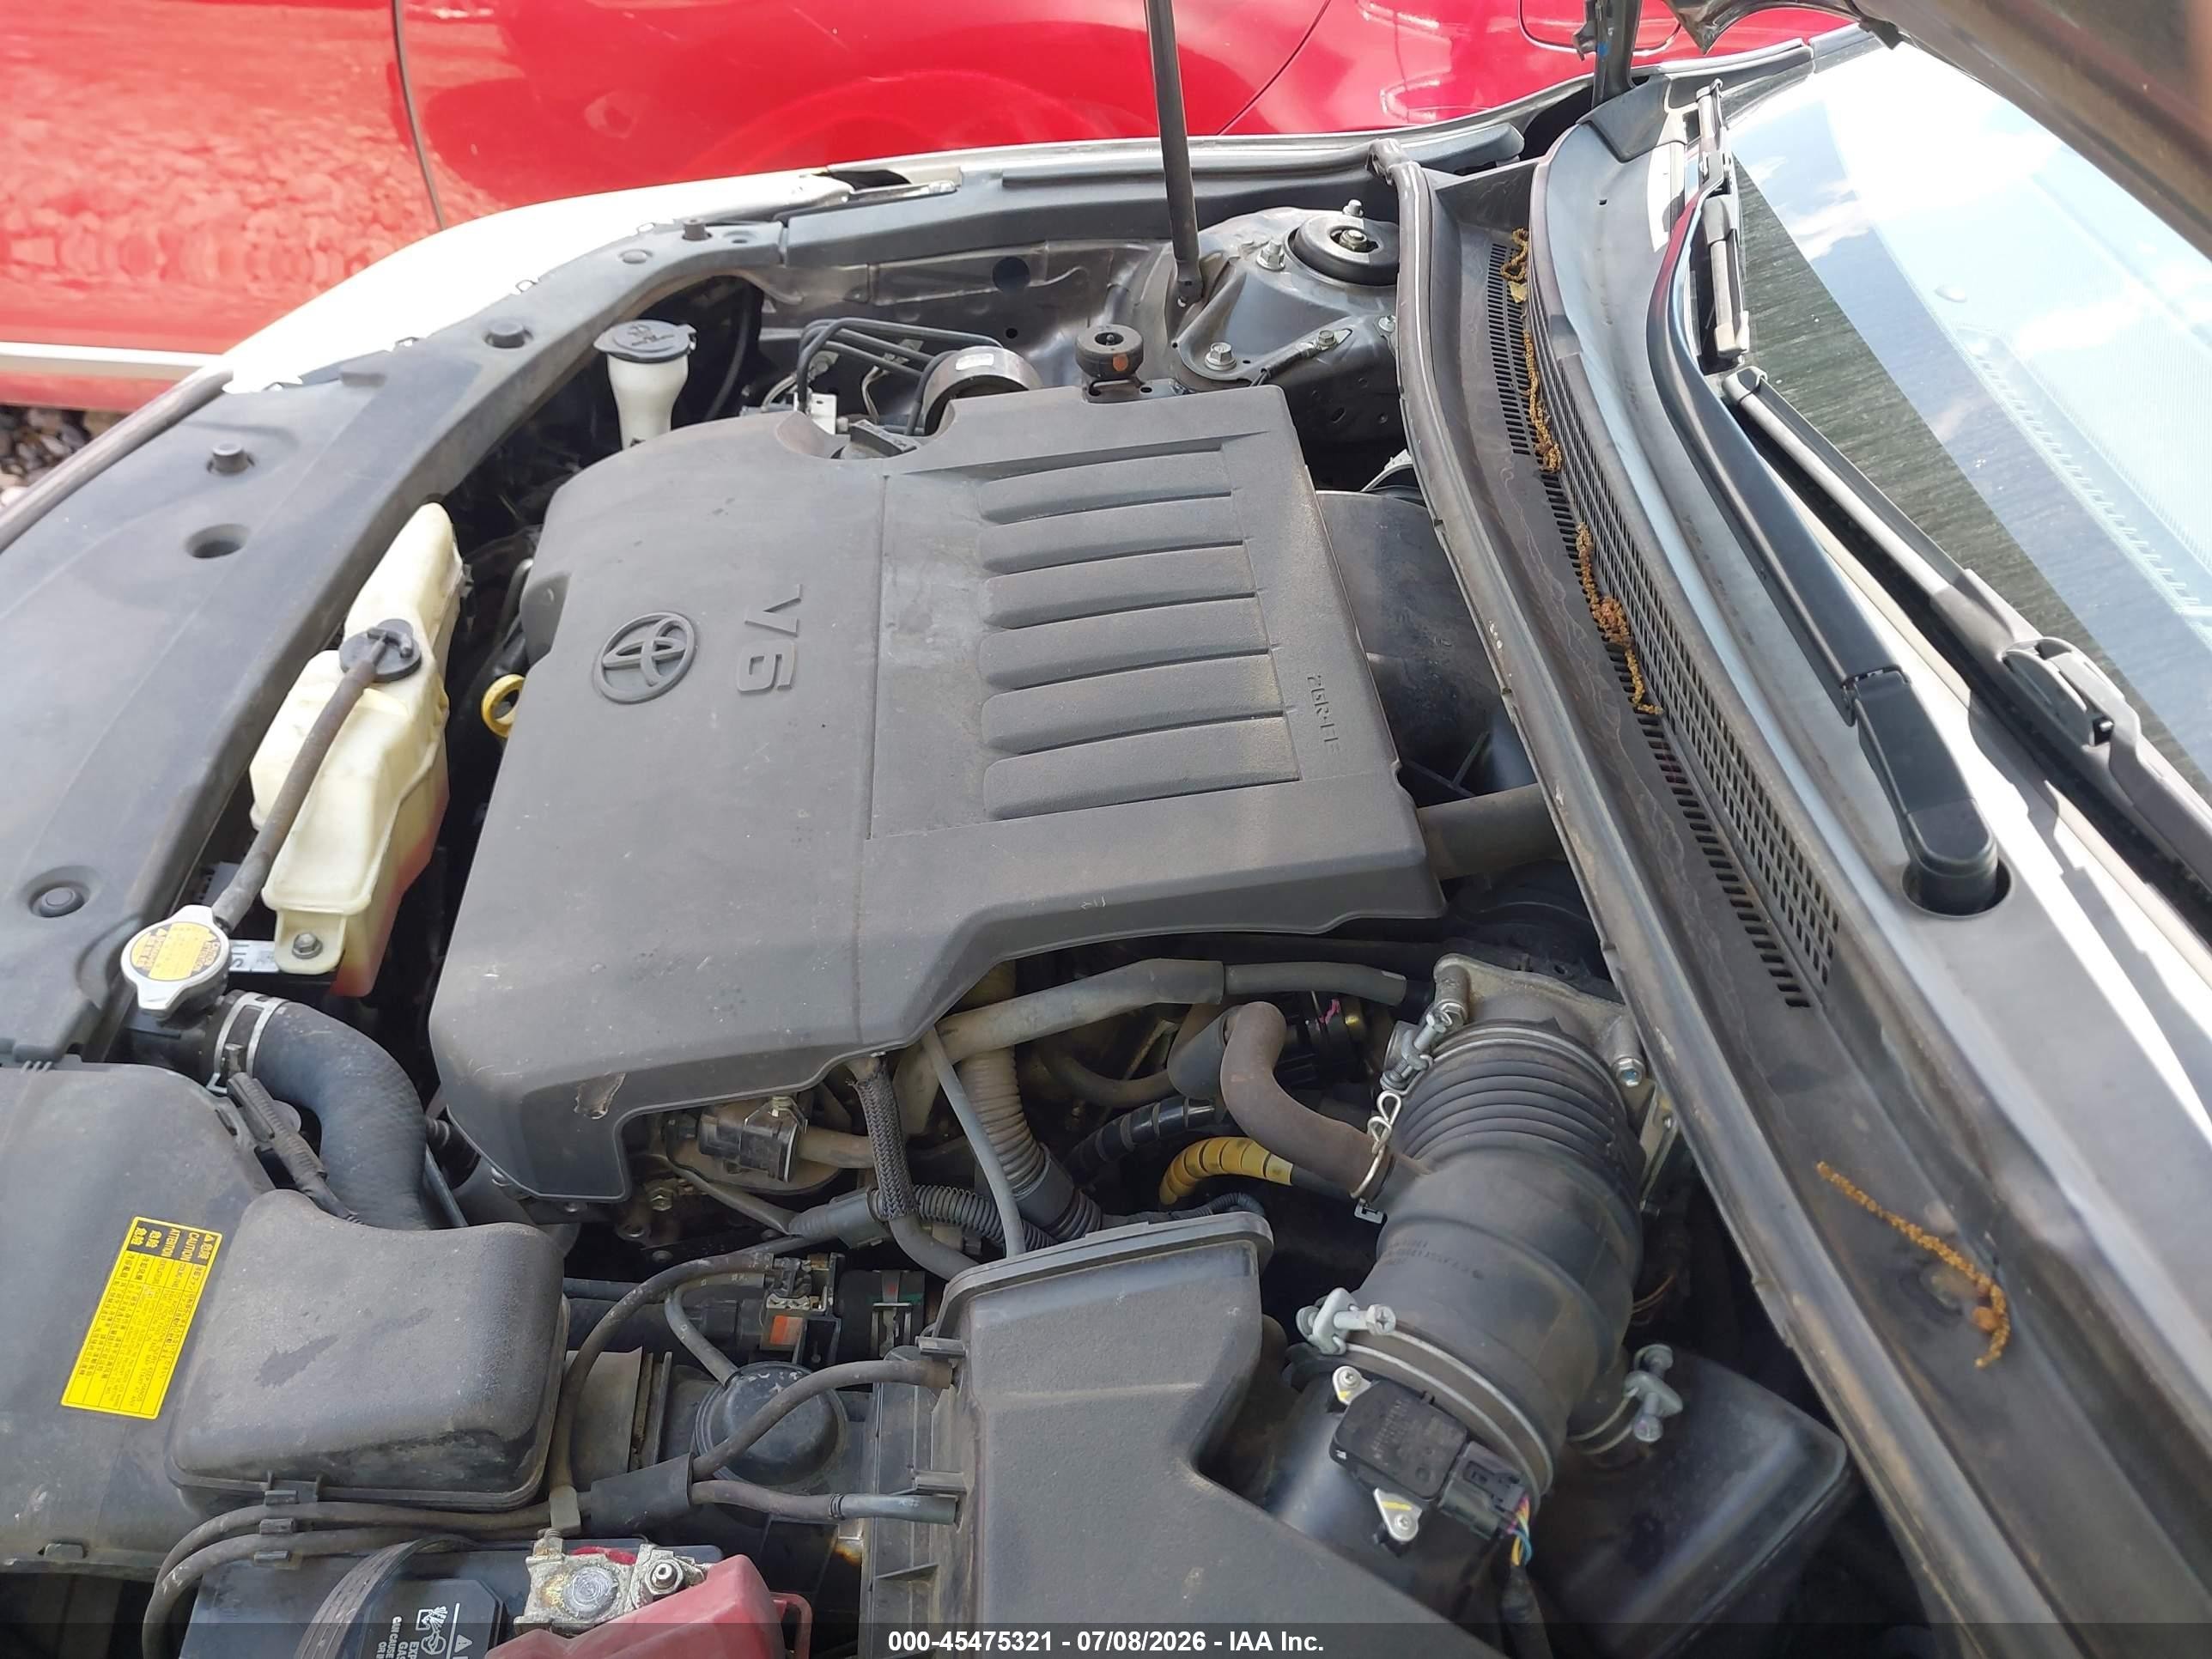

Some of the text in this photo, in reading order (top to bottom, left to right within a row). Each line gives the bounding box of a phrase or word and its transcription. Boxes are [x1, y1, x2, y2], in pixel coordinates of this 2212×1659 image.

[736, 584, 804, 695] V6
[160, 1228, 181, 1257] ATTENTION
[179, 1231, 200, 1261] CAUTION
[391, 1616, 403, 1633] CAN
[377, 1641, 387, 1653] OR
